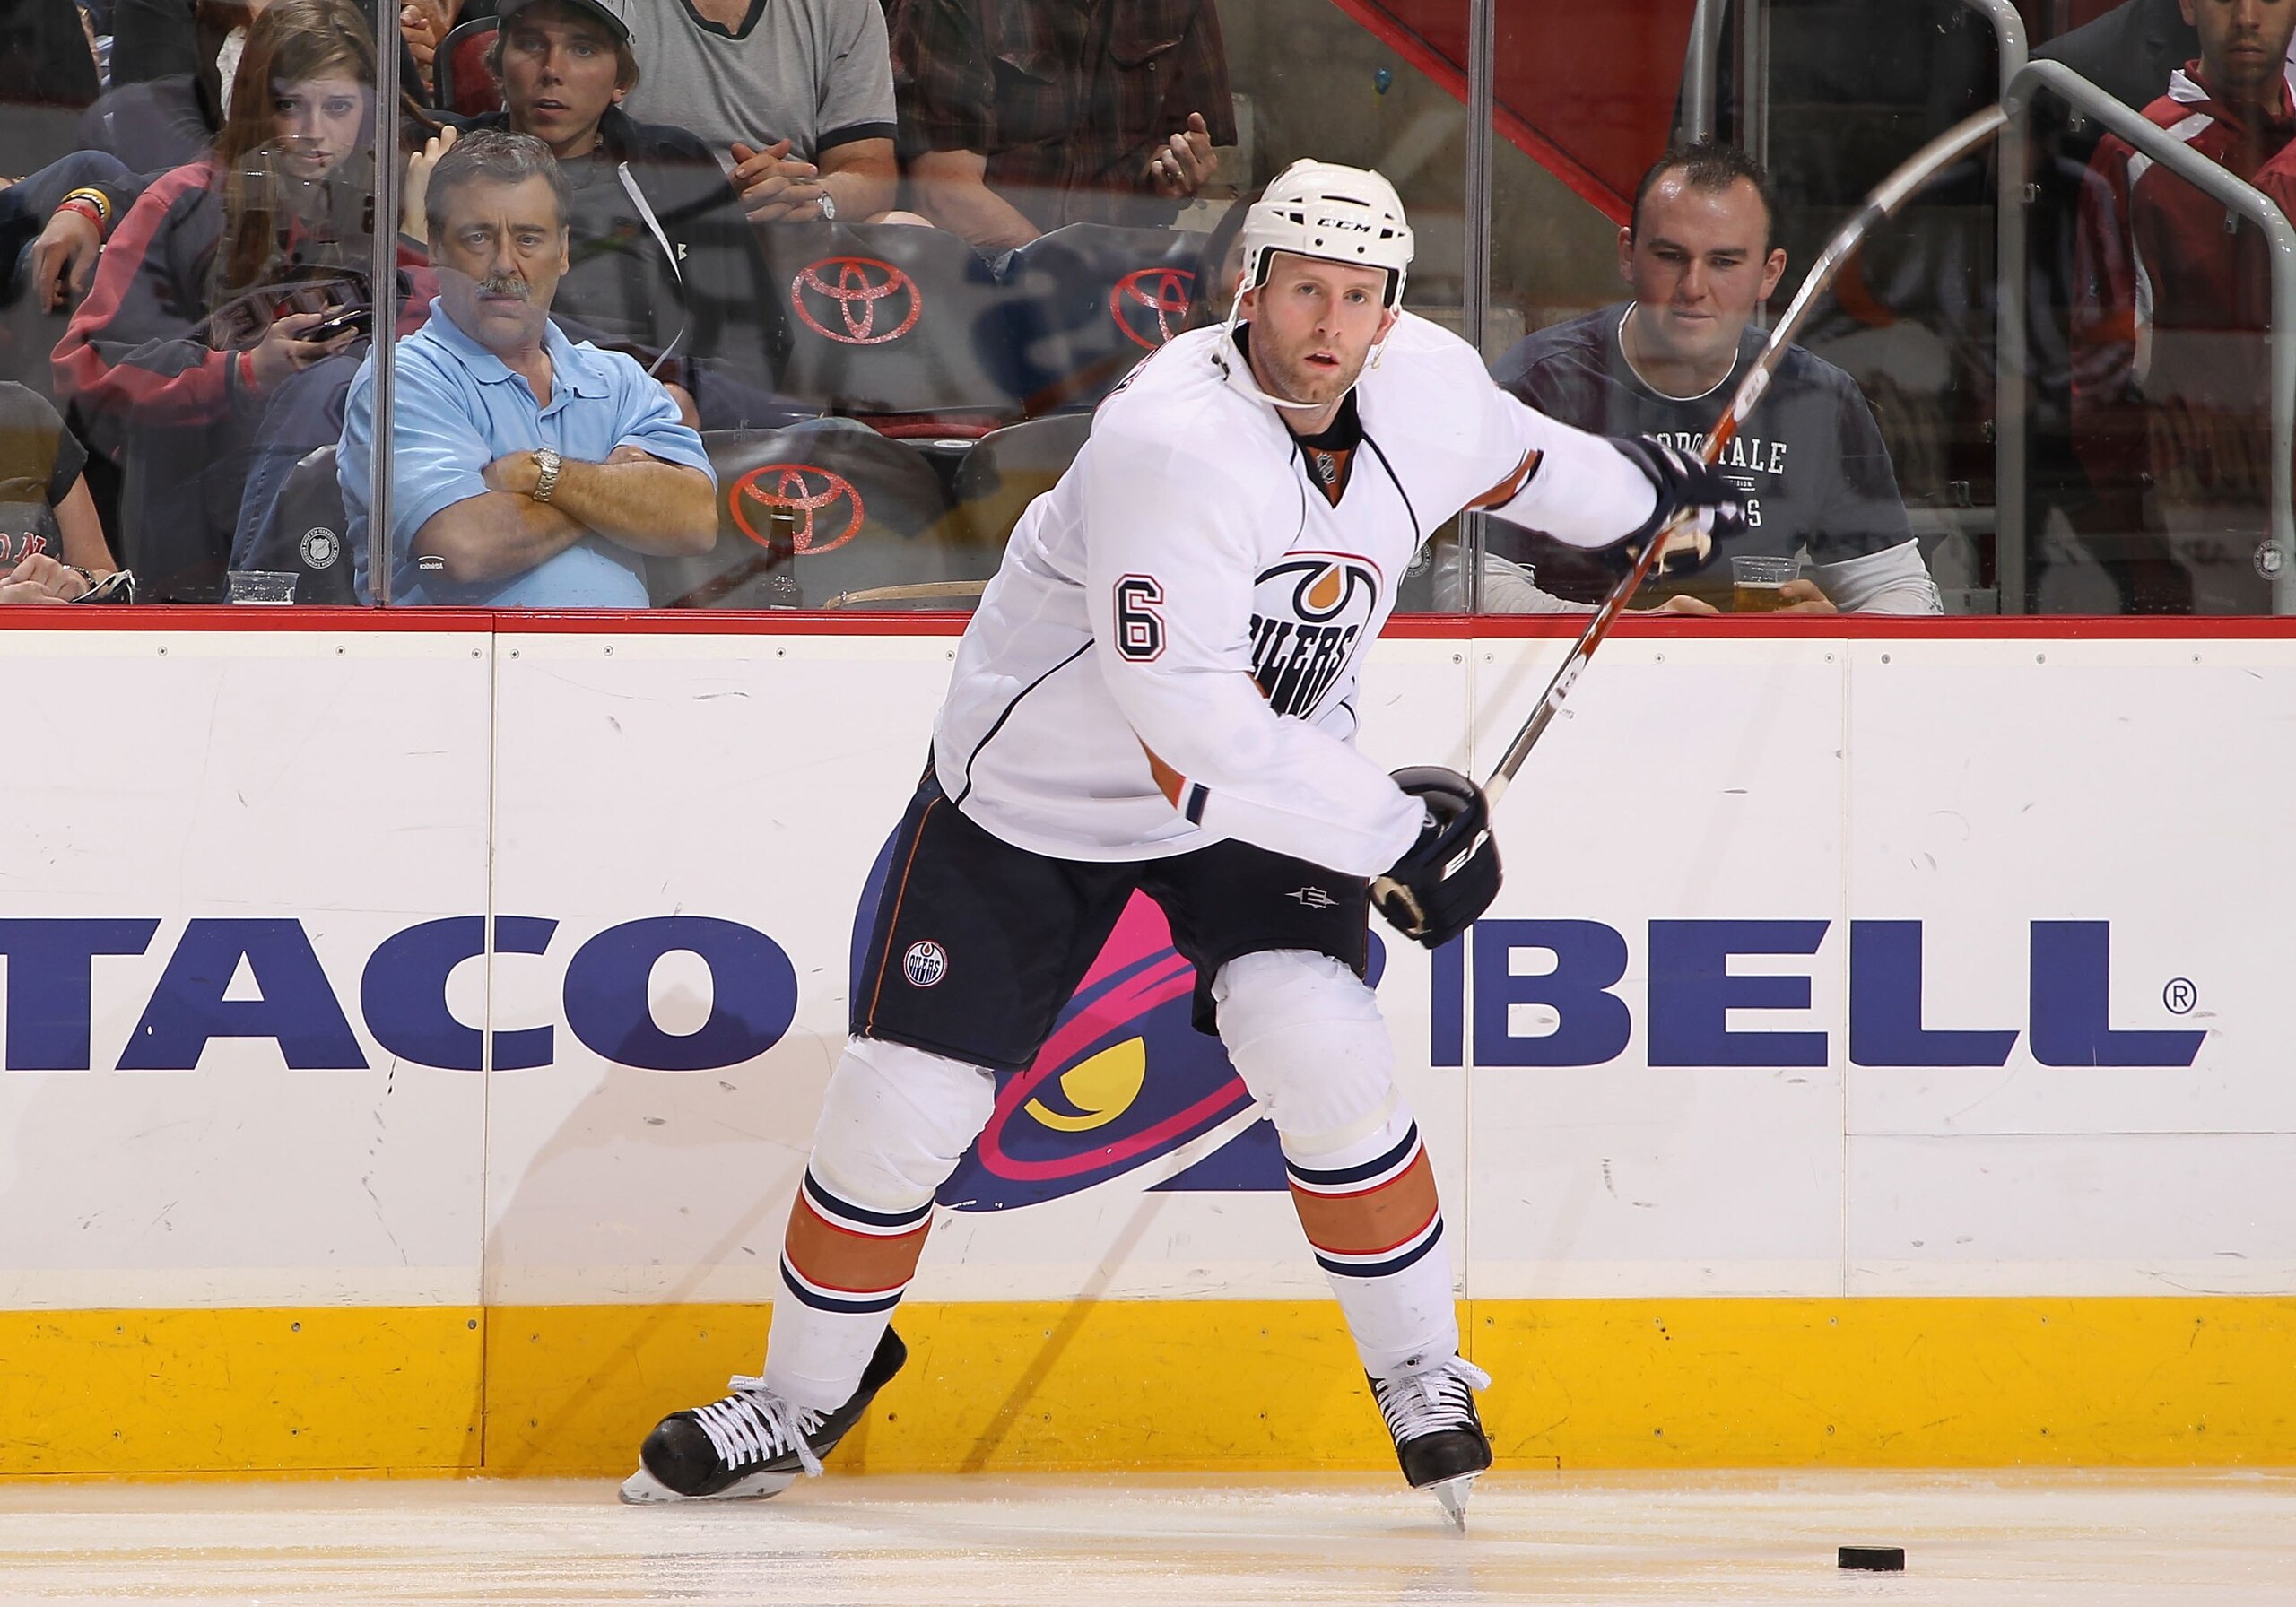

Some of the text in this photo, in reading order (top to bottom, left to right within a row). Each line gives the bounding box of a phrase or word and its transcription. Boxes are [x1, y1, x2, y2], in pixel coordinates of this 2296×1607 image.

[1317, 218, 1372, 233] CCM
[1113, 573, 1168, 662] 6
[0, 916, 798, 1071] TACO
[1431, 919, 2207, 1067] BELL
[909, 954, 941, 983] OILERS
